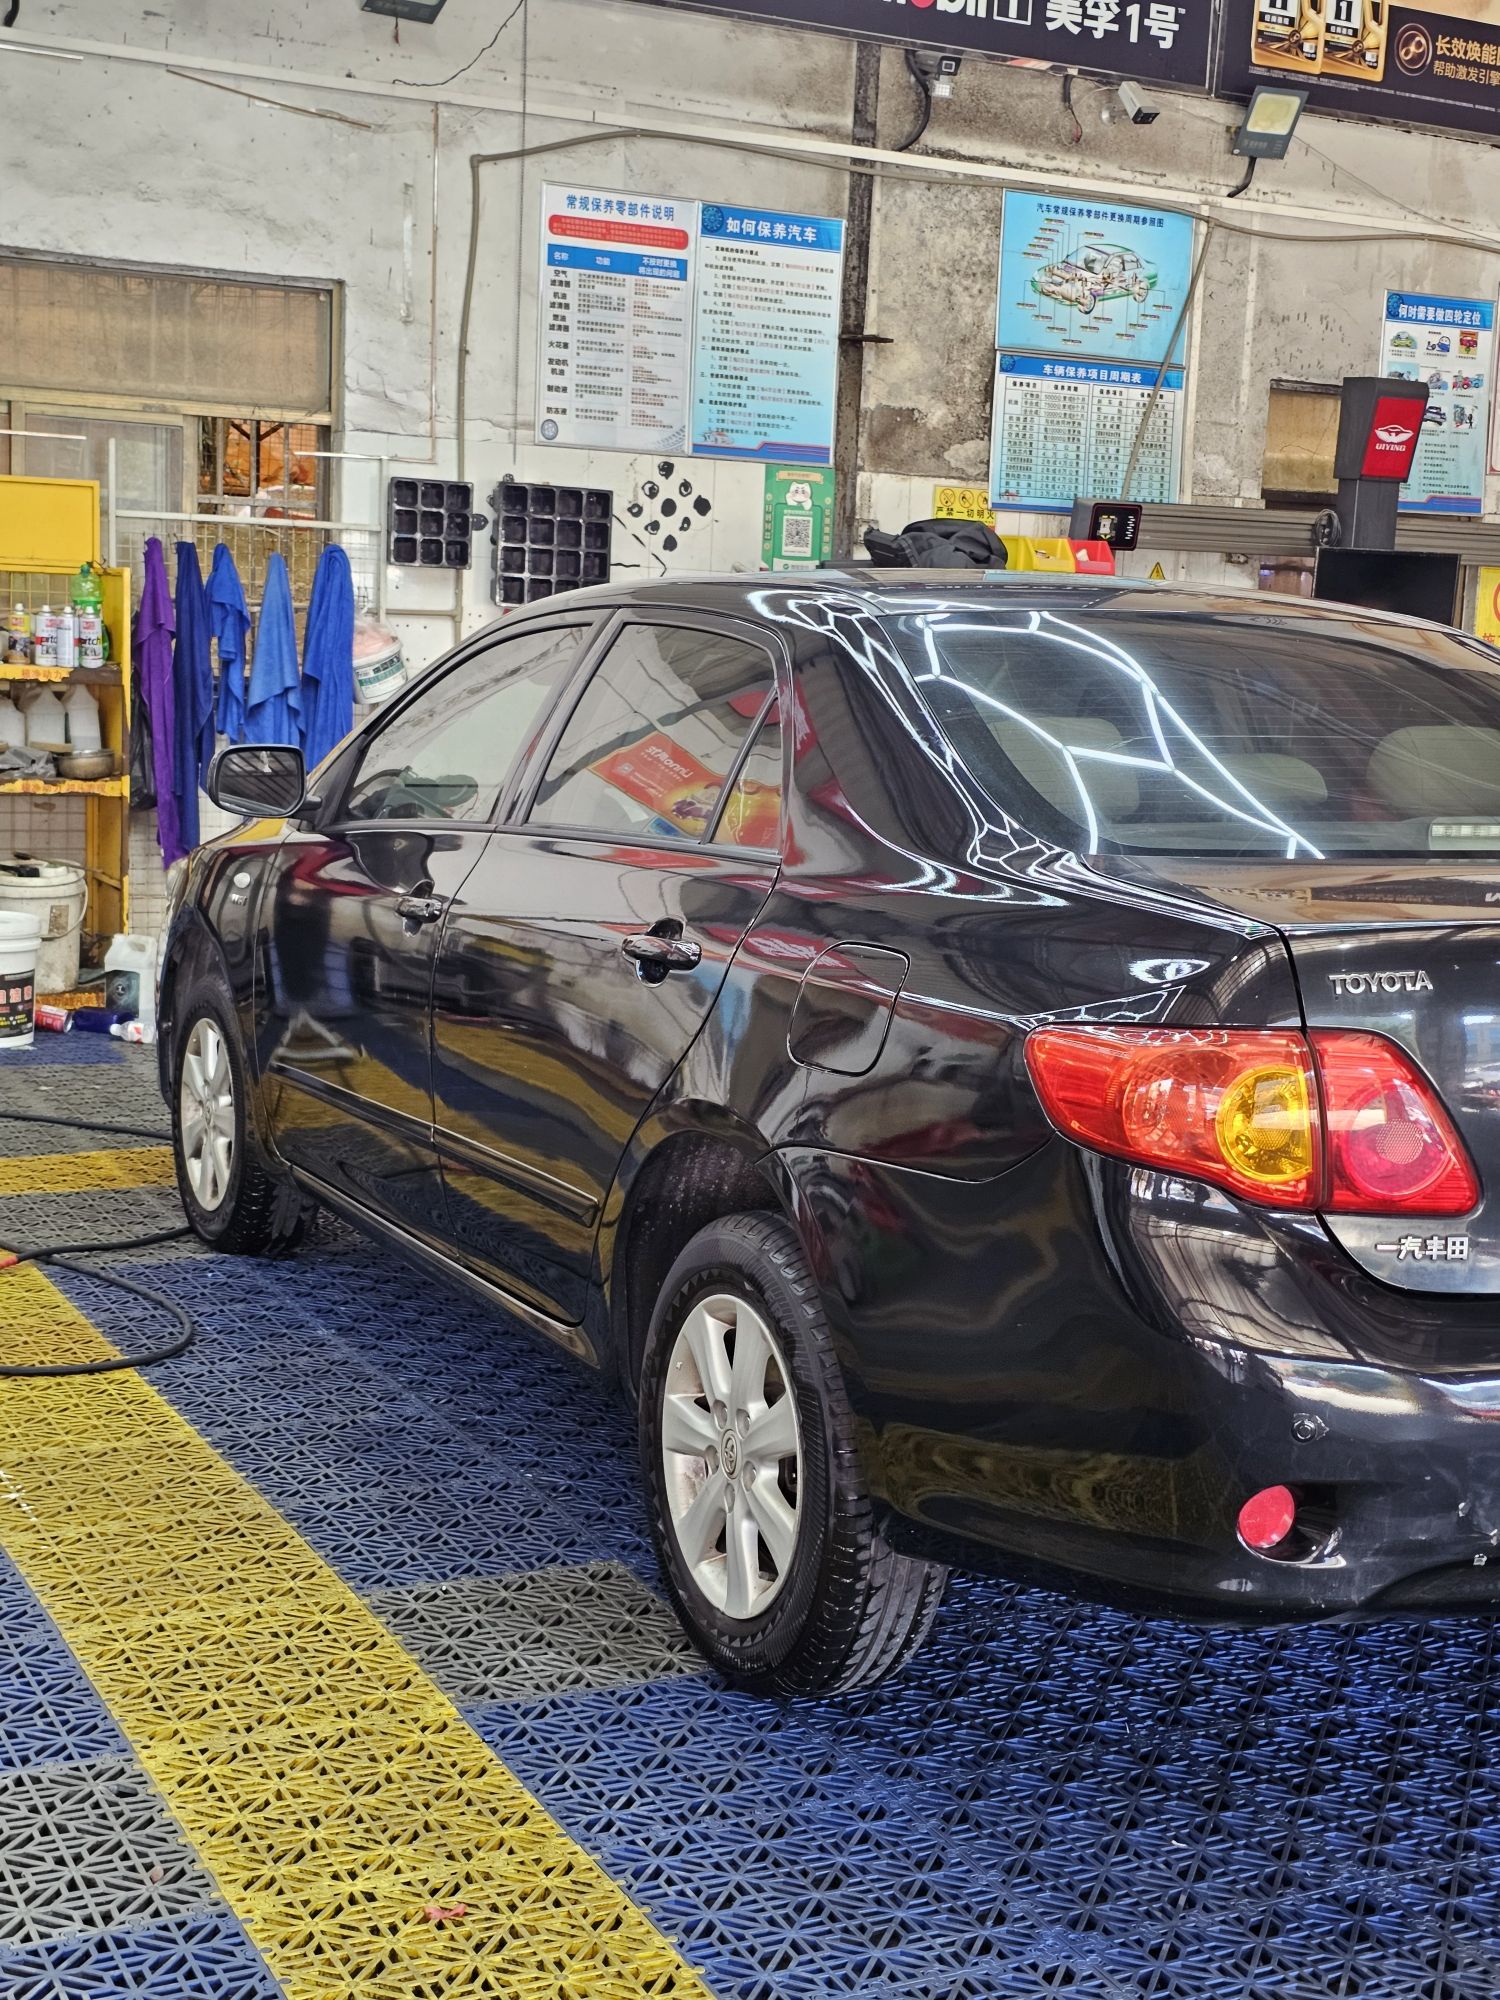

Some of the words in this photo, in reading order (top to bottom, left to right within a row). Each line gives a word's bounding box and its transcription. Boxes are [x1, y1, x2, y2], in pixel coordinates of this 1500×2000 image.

[1435, 34, 1500, 66] 长效焕能
[566, 193, 675, 221] 常规保养零部件说明
[1036, 202, 1164, 228] 汽车常规保养零部件更换周期参照图
[726, 216, 817, 243] 如何保养汽车
[1398, 303, 1482, 326] 何时需要做四轮定位
[1042, 363, 1142, 384] 车辆保养项目周期表
[936, 506, 994, 520] 严禁一切明火
[1328, 969, 1434, 995] TOYOTA
[1374, 1233, 1469, 1261] 一汽丰田
